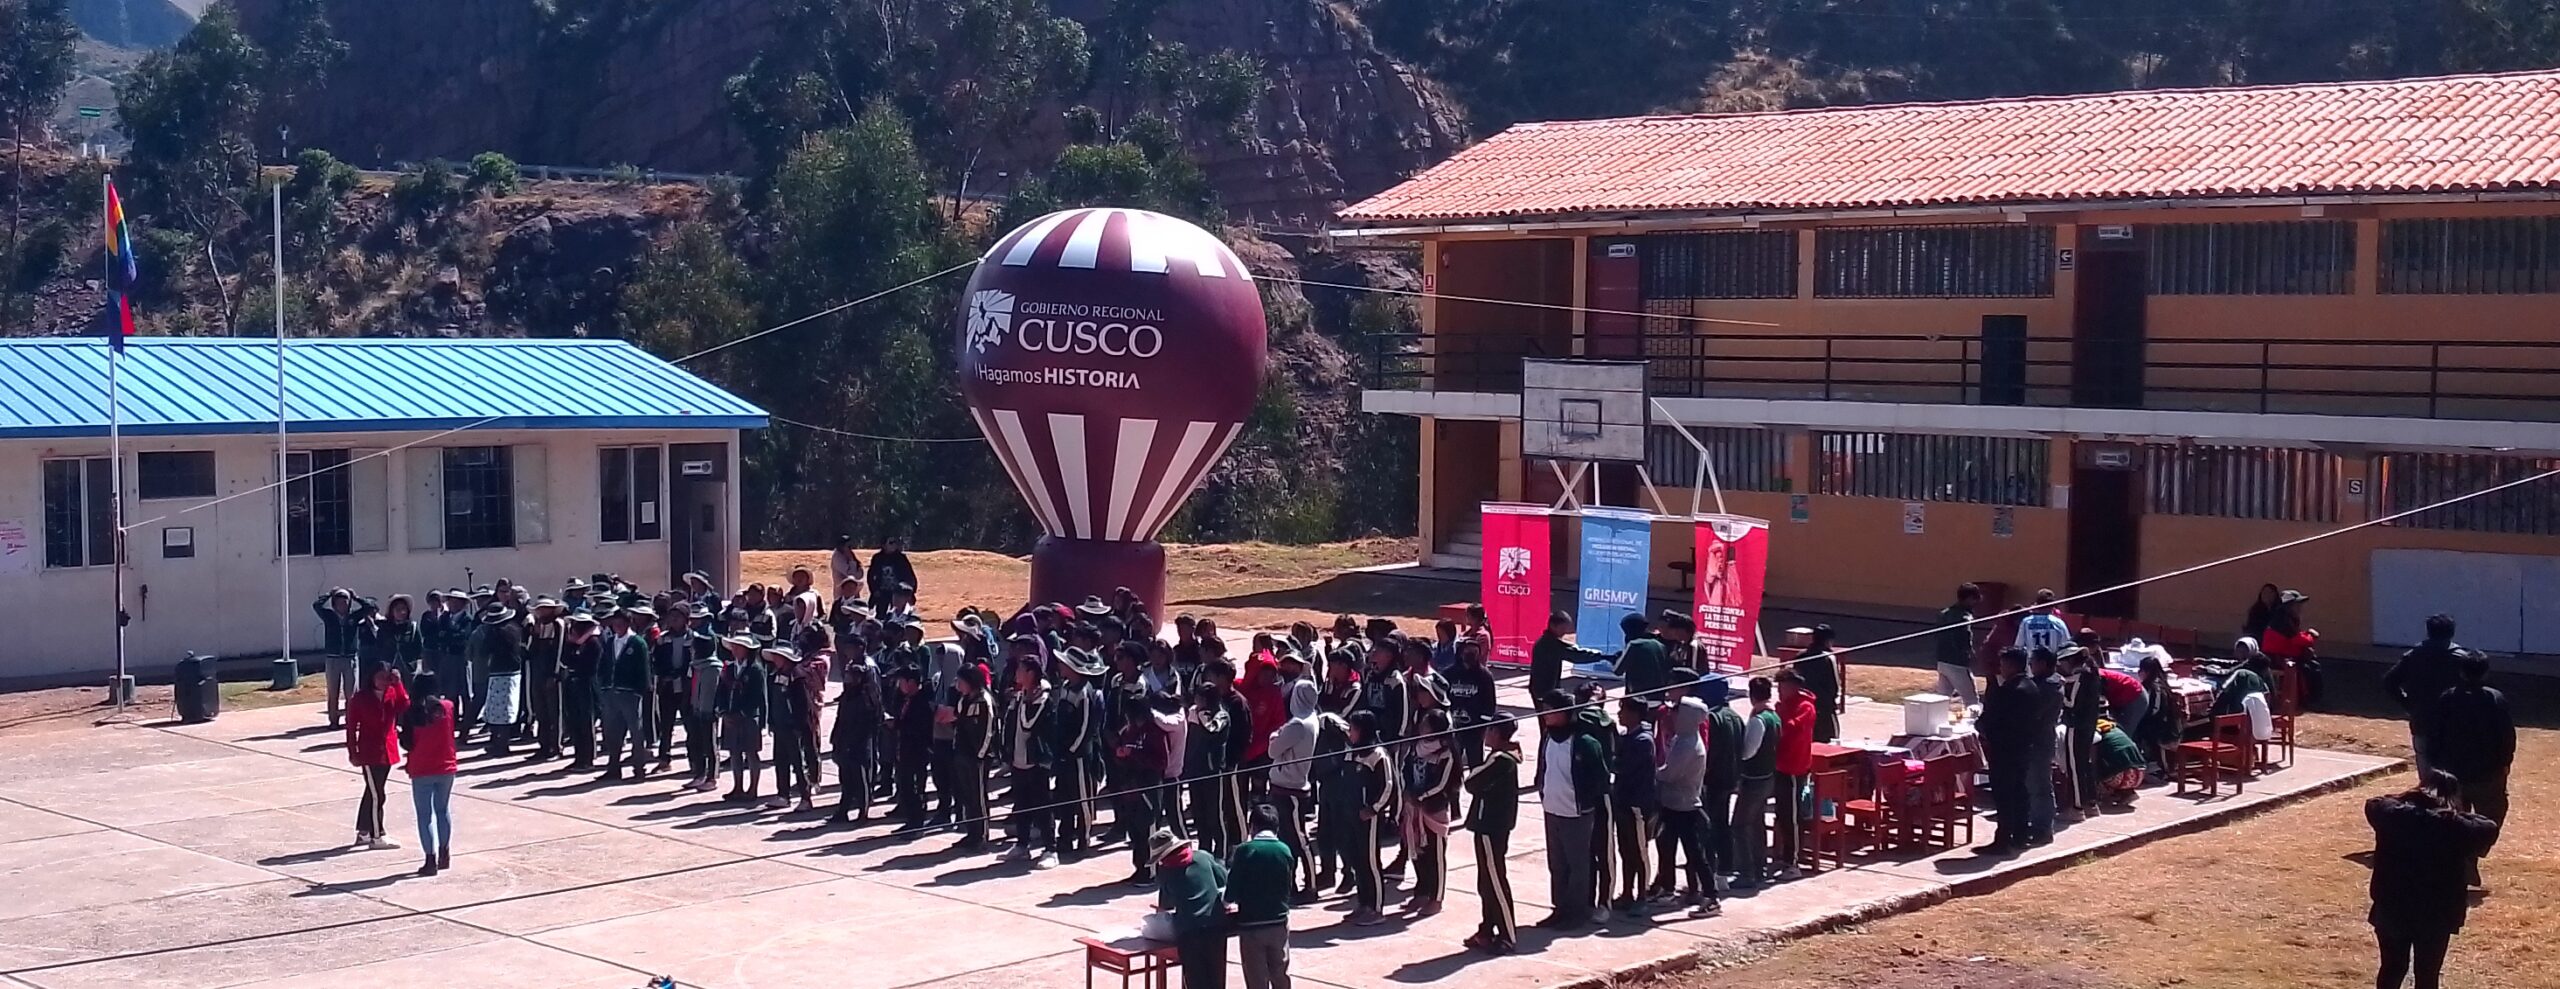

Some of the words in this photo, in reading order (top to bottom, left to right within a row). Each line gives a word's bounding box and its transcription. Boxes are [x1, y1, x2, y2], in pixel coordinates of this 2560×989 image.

[1020, 302, 1089, 317] GOBIERNO
[1092, 305, 1165, 322] REGIONAL
[1018, 318, 1164, 358] CUSCO
[1044, 367, 1141, 390] HISTORIA
[1497, 584, 1531, 596] CUSCO
[1584, 587, 1639, 605] GRISMPV
[2032, 632, 2051, 646] 11
